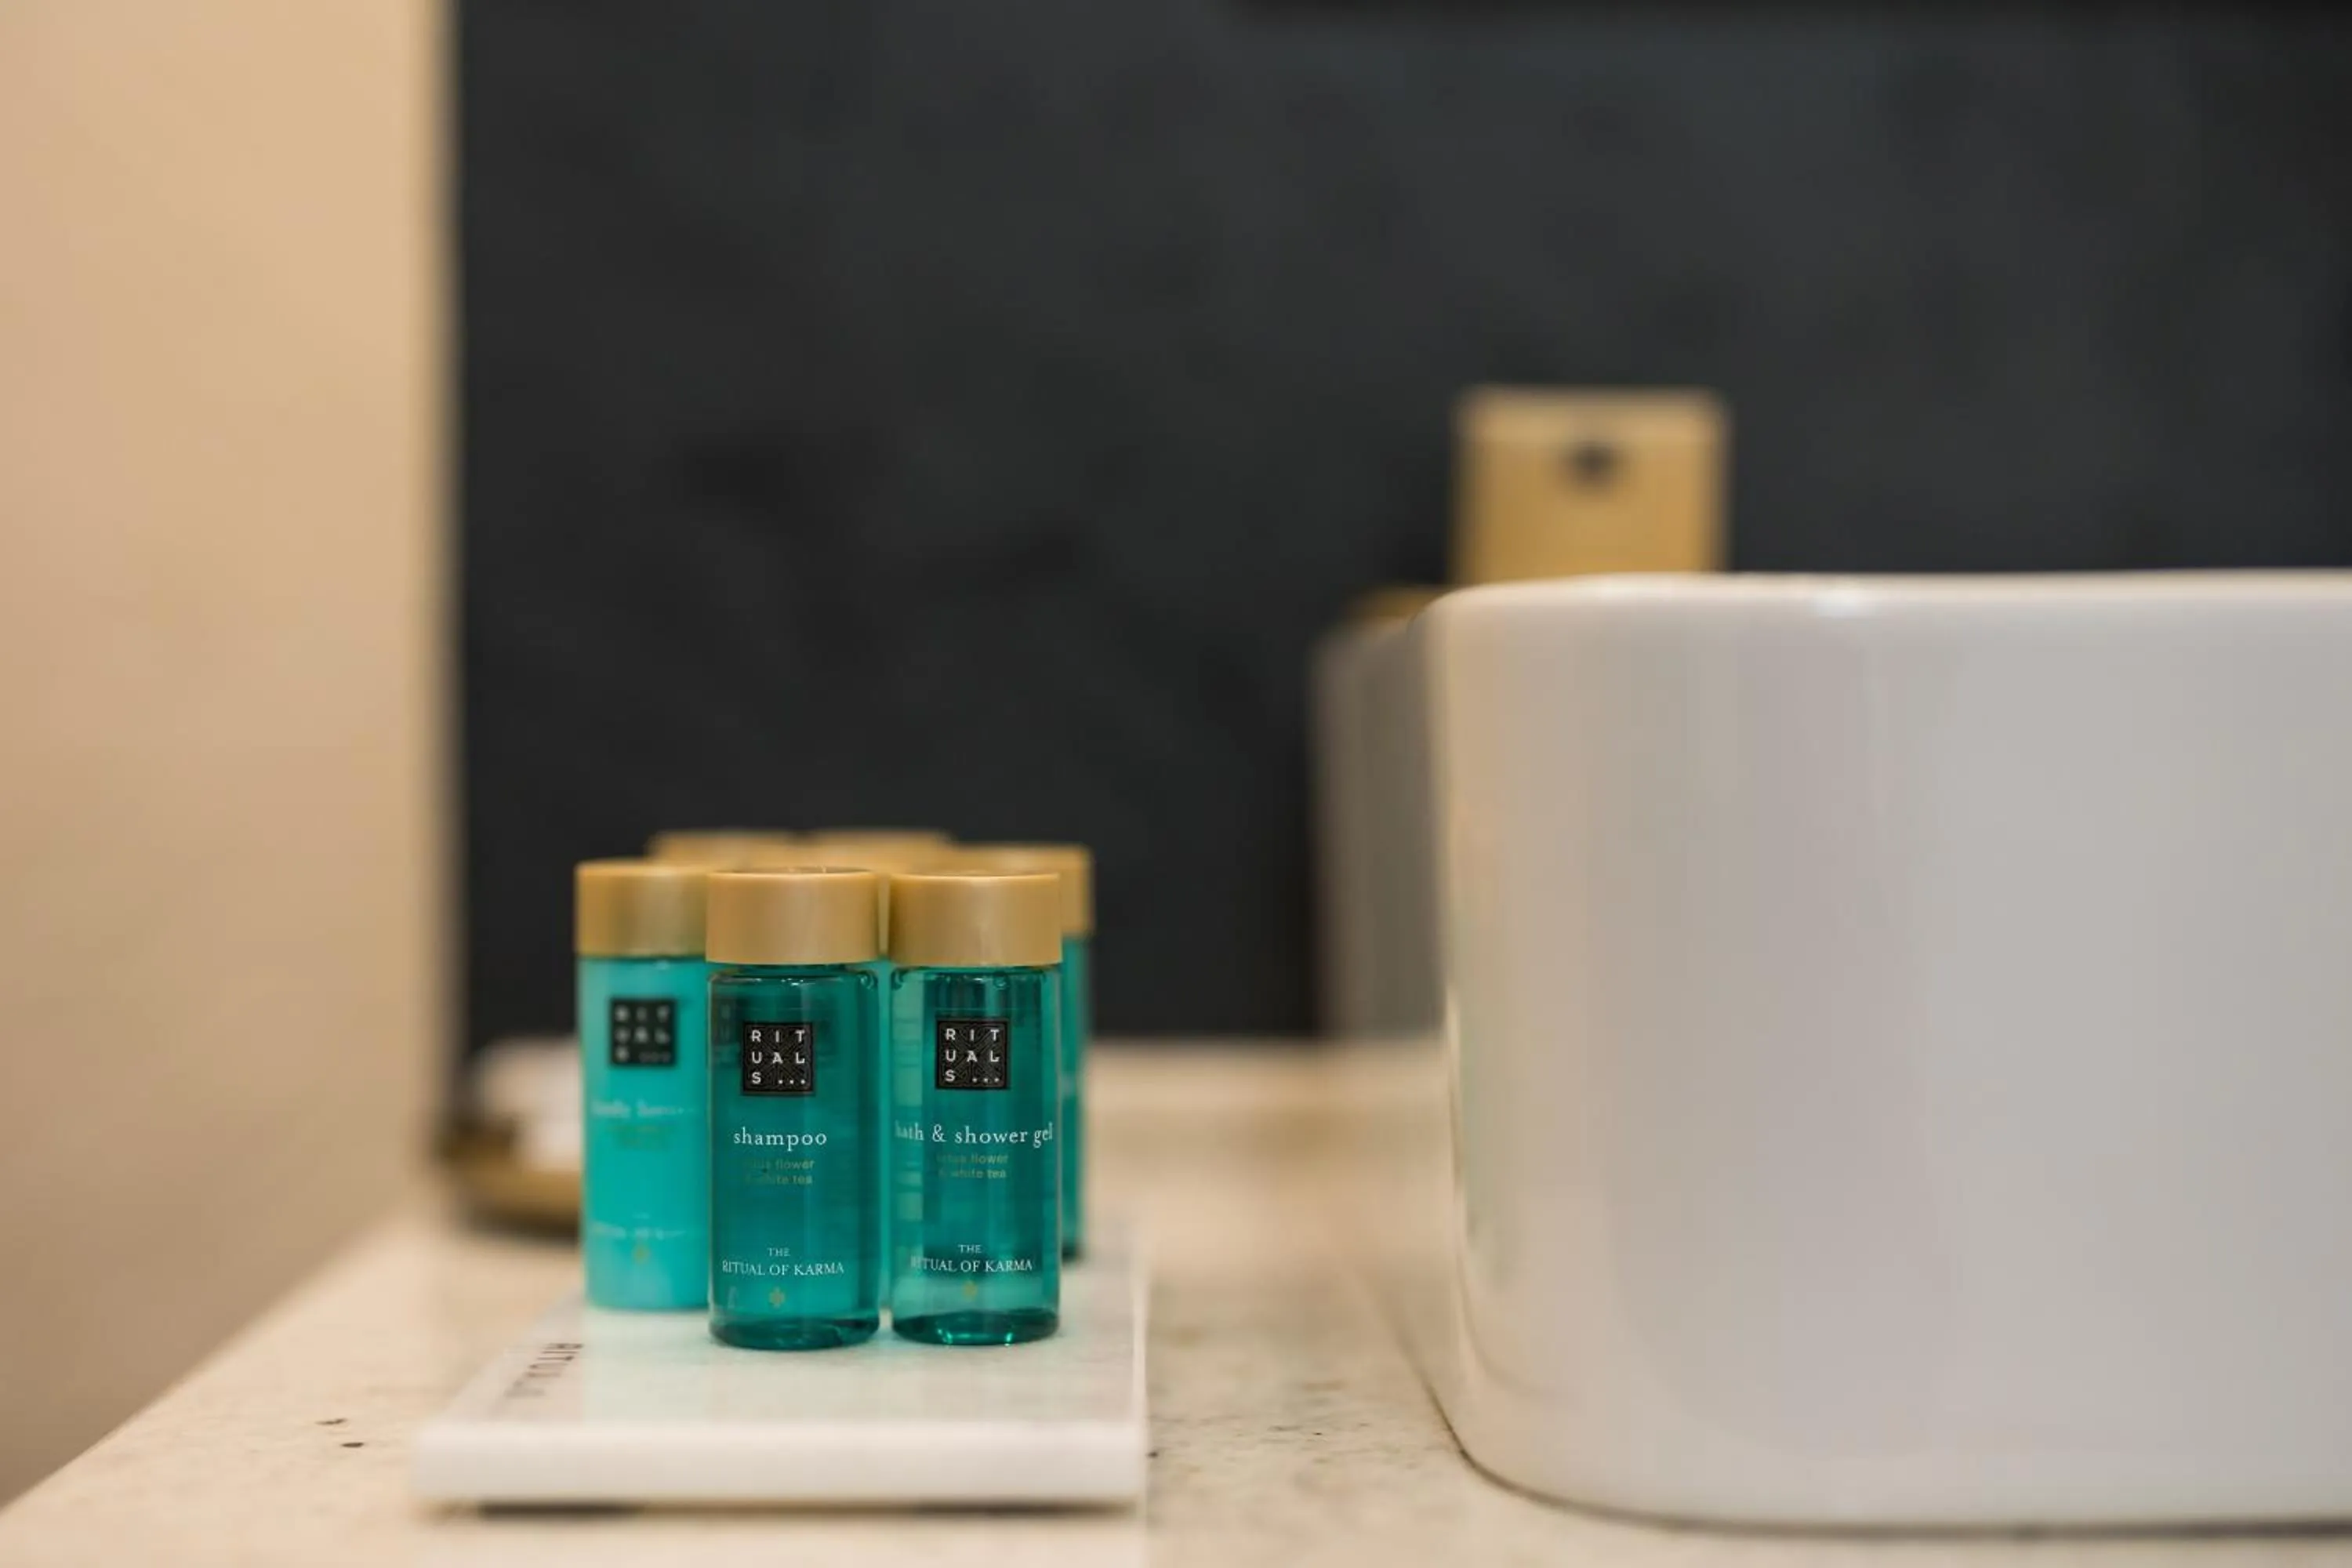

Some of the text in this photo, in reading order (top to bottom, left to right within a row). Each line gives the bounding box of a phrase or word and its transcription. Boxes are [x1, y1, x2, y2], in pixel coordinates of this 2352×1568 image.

[751, 1029, 805, 1043] RIT
[946, 1028, 1000, 1041] RIT
[751, 1051, 805, 1064] UAL
[946, 1050, 1000, 1062] UAL
[733, 1126, 827, 1152] shampoo
[931, 1123, 947, 1142] &
[954, 1125, 1028, 1144] shower
[1033, 1121, 1053, 1149] gel
[768, 1247, 790, 1257] THE
[958, 1243, 982, 1254] THE
[722, 1259, 844, 1276] RITUAL OF KARMA
[960, 1260, 981, 1272] OF
[985, 1258, 1033, 1272] KARMA
